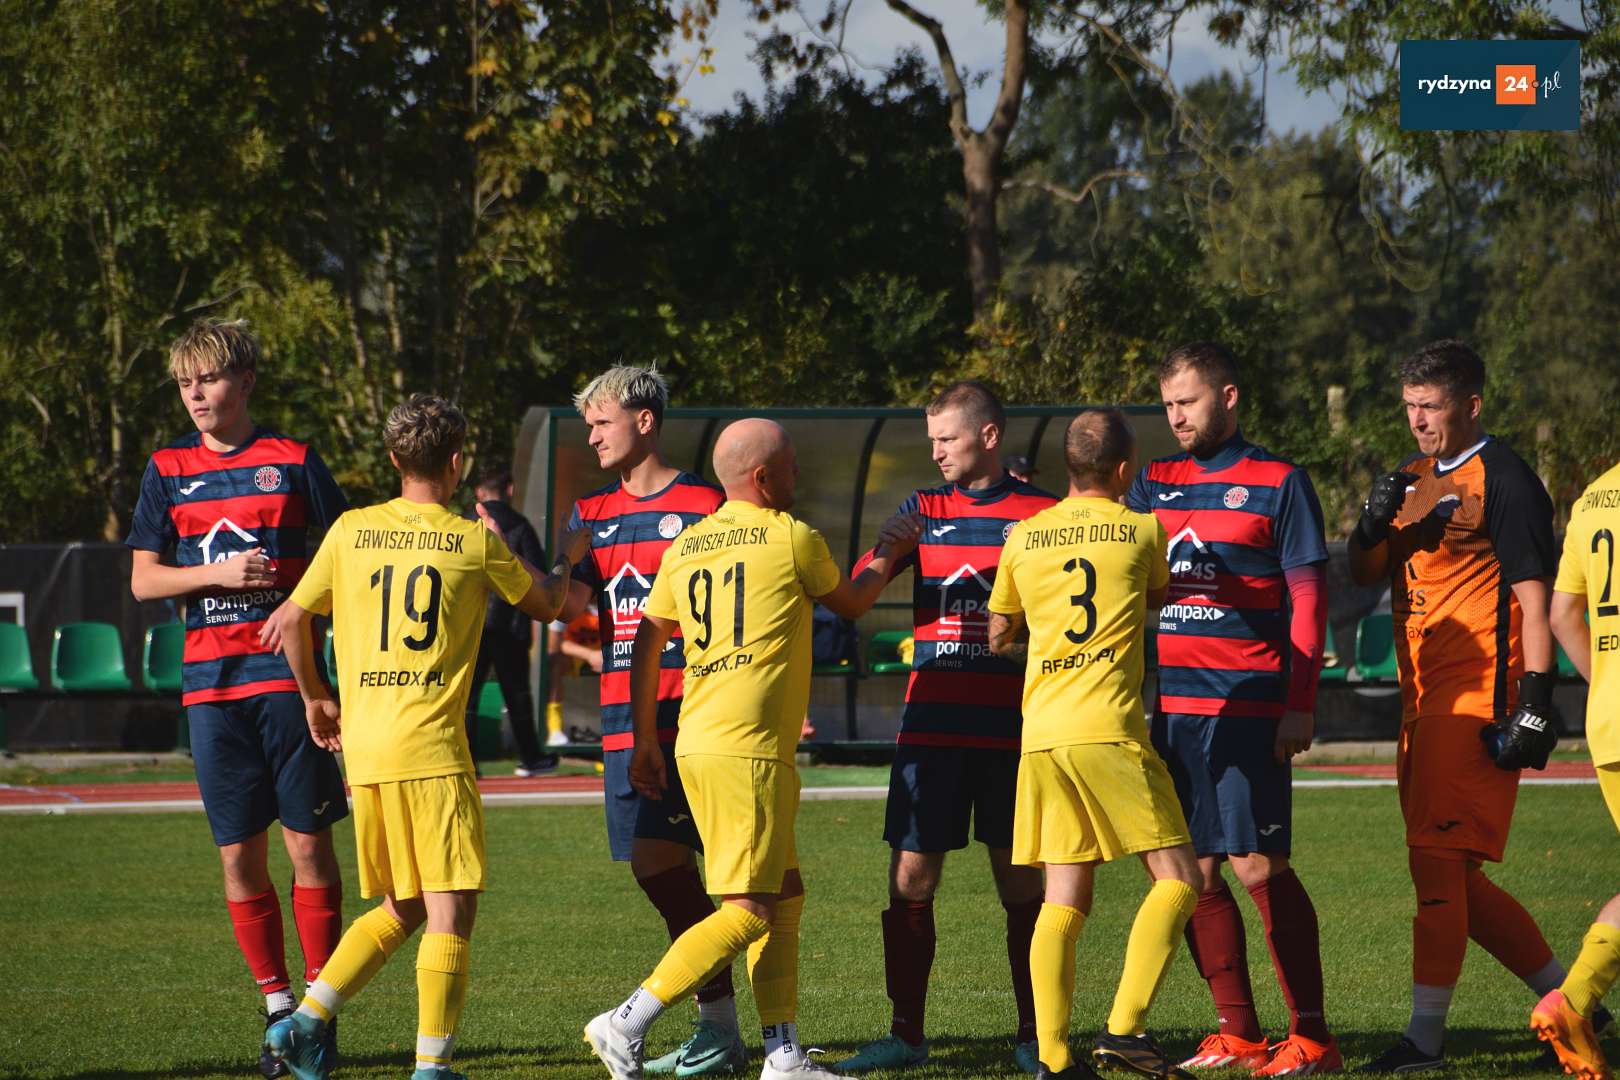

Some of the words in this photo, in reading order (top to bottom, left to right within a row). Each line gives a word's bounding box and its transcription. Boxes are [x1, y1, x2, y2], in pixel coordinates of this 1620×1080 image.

[1071, 509, 1090, 521] 1946
[354, 529, 415, 550] ZAWISZA
[418, 531, 464, 554] DOLSK
[681, 532, 725, 557] ZAWISZA
[726, 526, 768, 547] DOLSK
[1025, 526, 1084, 550] ZAWISZA
[1089, 523, 1137, 545] DOLSK
[1171, 561, 1216, 580] 4P4S
[203, 590, 274, 615] pompax
[371, 564, 442, 652] 19
[618, 596, 648, 616] 4P4
[688, 561, 745, 651] 91
[949, 599, 988, 617] 4P4
[1063, 557, 1097, 644] 3
[206, 613, 239, 624] SERWIS
[935, 641, 995, 660] pompa
[360, 671, 446, 687] REDBOX.PL
